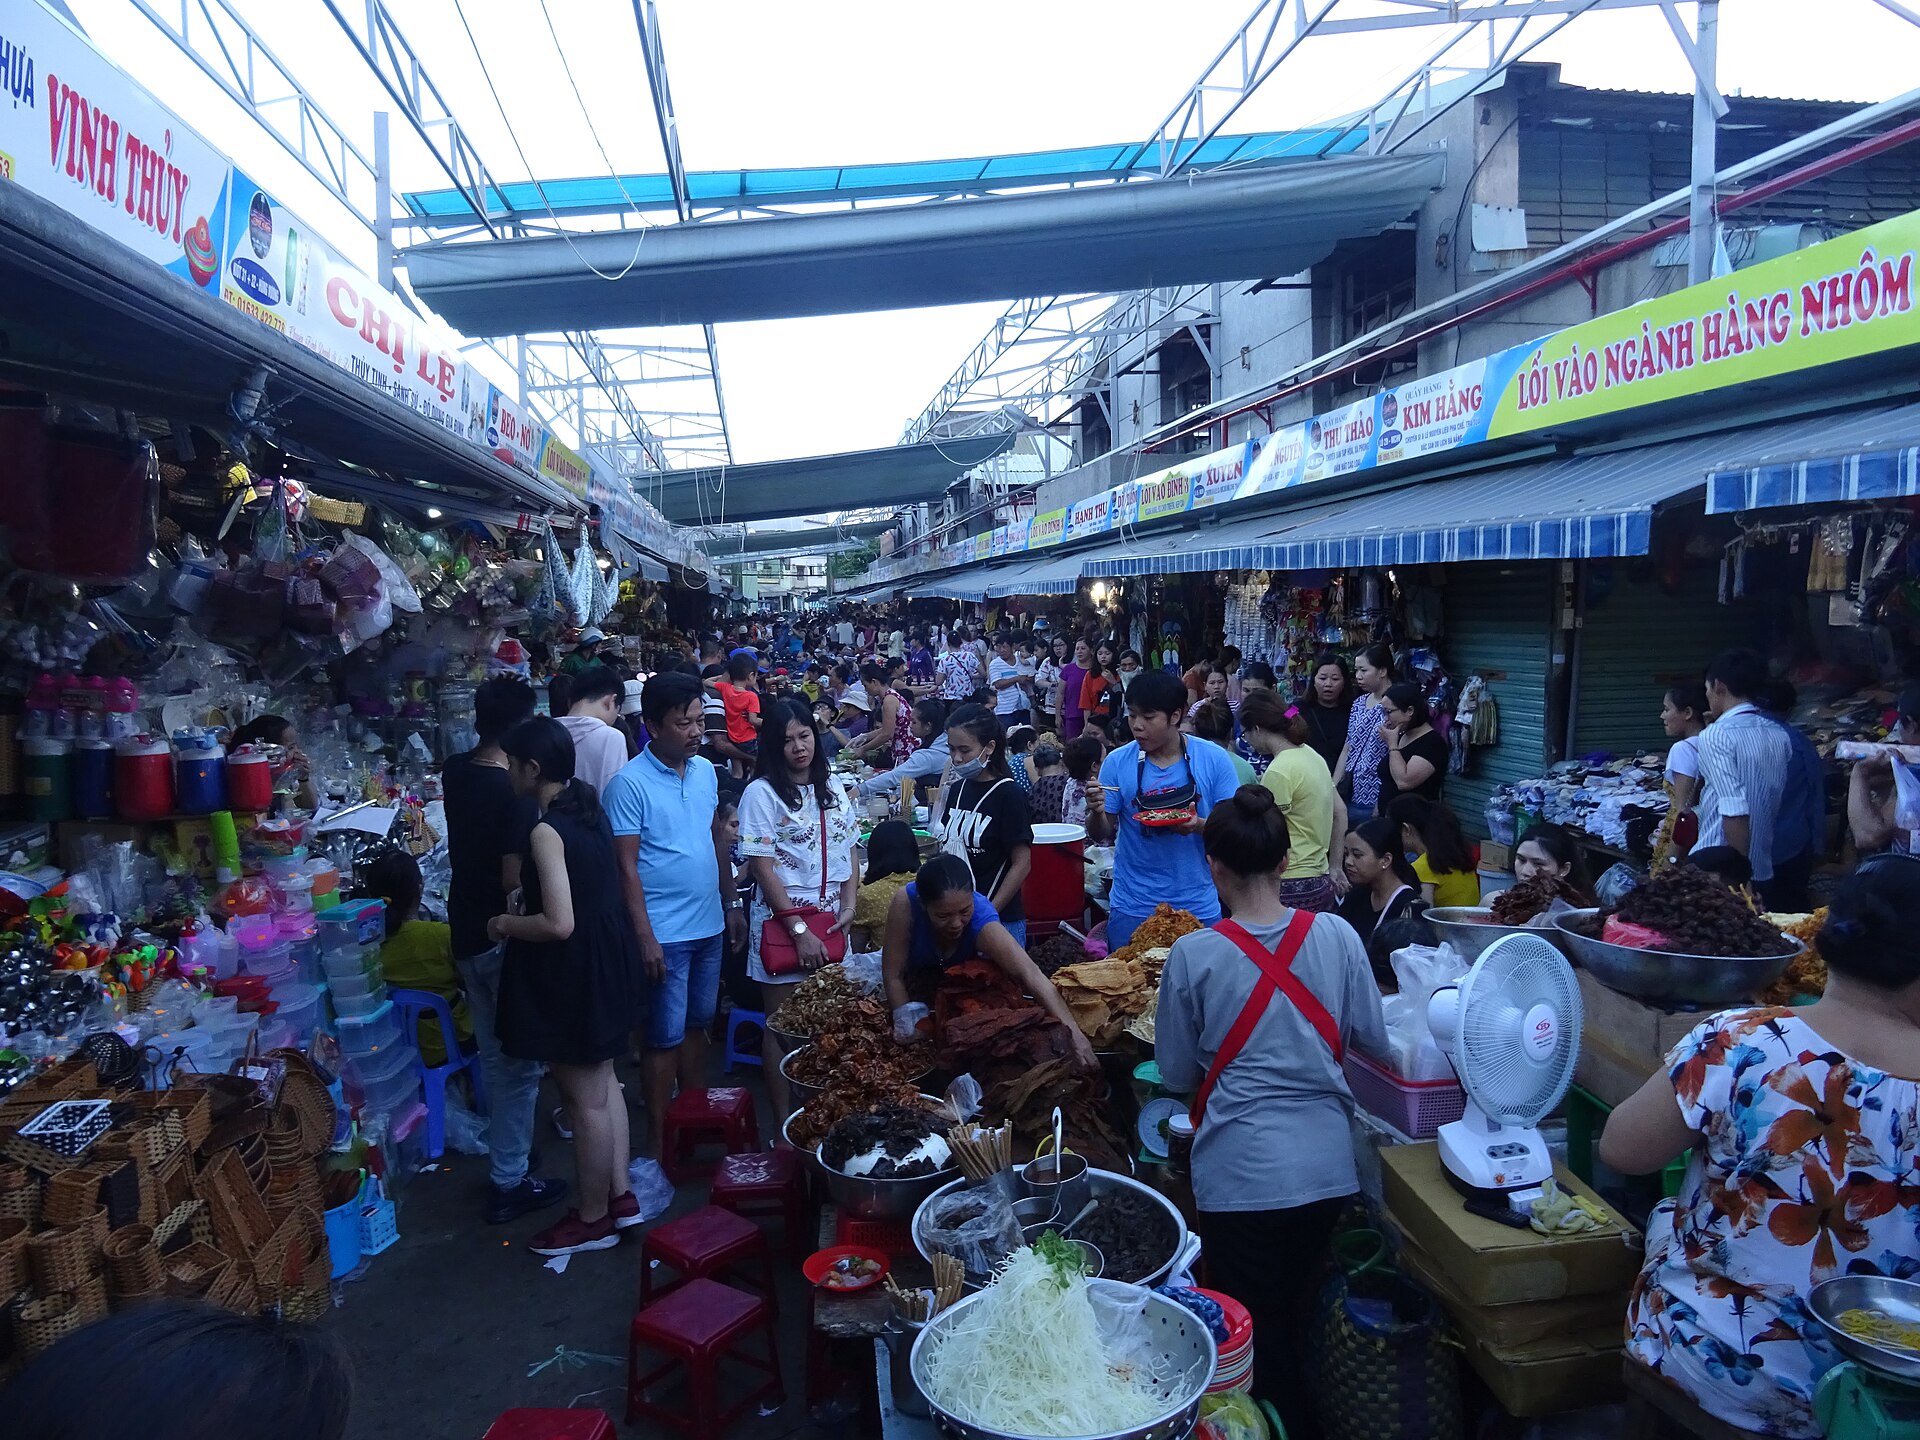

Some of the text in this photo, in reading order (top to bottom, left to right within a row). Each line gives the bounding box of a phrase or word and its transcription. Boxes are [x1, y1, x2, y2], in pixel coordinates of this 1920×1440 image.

[47, 74, 189, 245] VINH THỦY
[326, 276, 407, 374] CHỊ
[1516, 244, 1913, 412] LỐI VÀO NGÀNH HÀNG NHÔM
[351, 354, 370, 384] THỦY
[372, 368, 388, 392] TINH
[1324, 427, 1343, 450] THU
[1344, 410, 1374, 443] THẢO
[1403, 400, 1431, 431] KIM
[1095, 501, 1108, 520] THU
